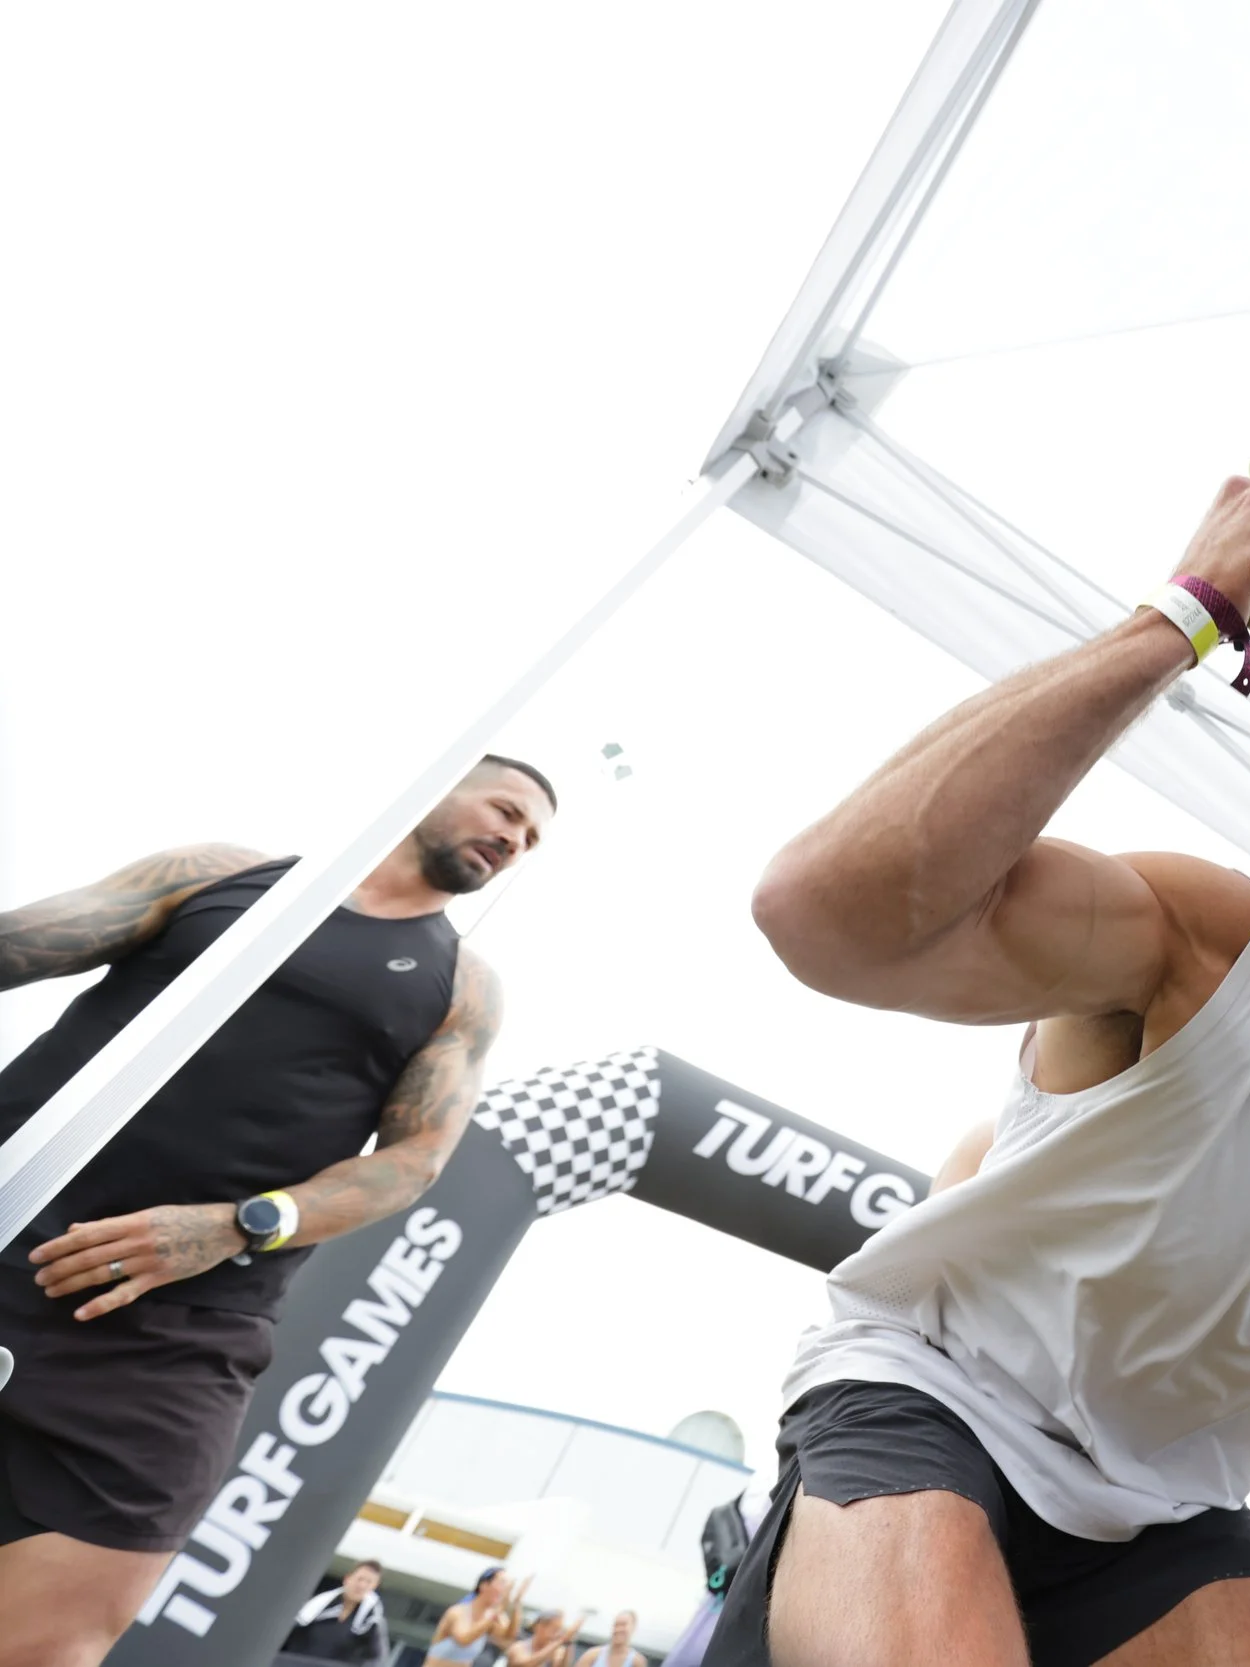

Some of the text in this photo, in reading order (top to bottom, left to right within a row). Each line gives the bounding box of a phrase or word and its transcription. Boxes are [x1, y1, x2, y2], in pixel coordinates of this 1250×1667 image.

[692, 1098, 867, 1205] TURF
[135, 1206, 463, 1638] TURF GAMES
